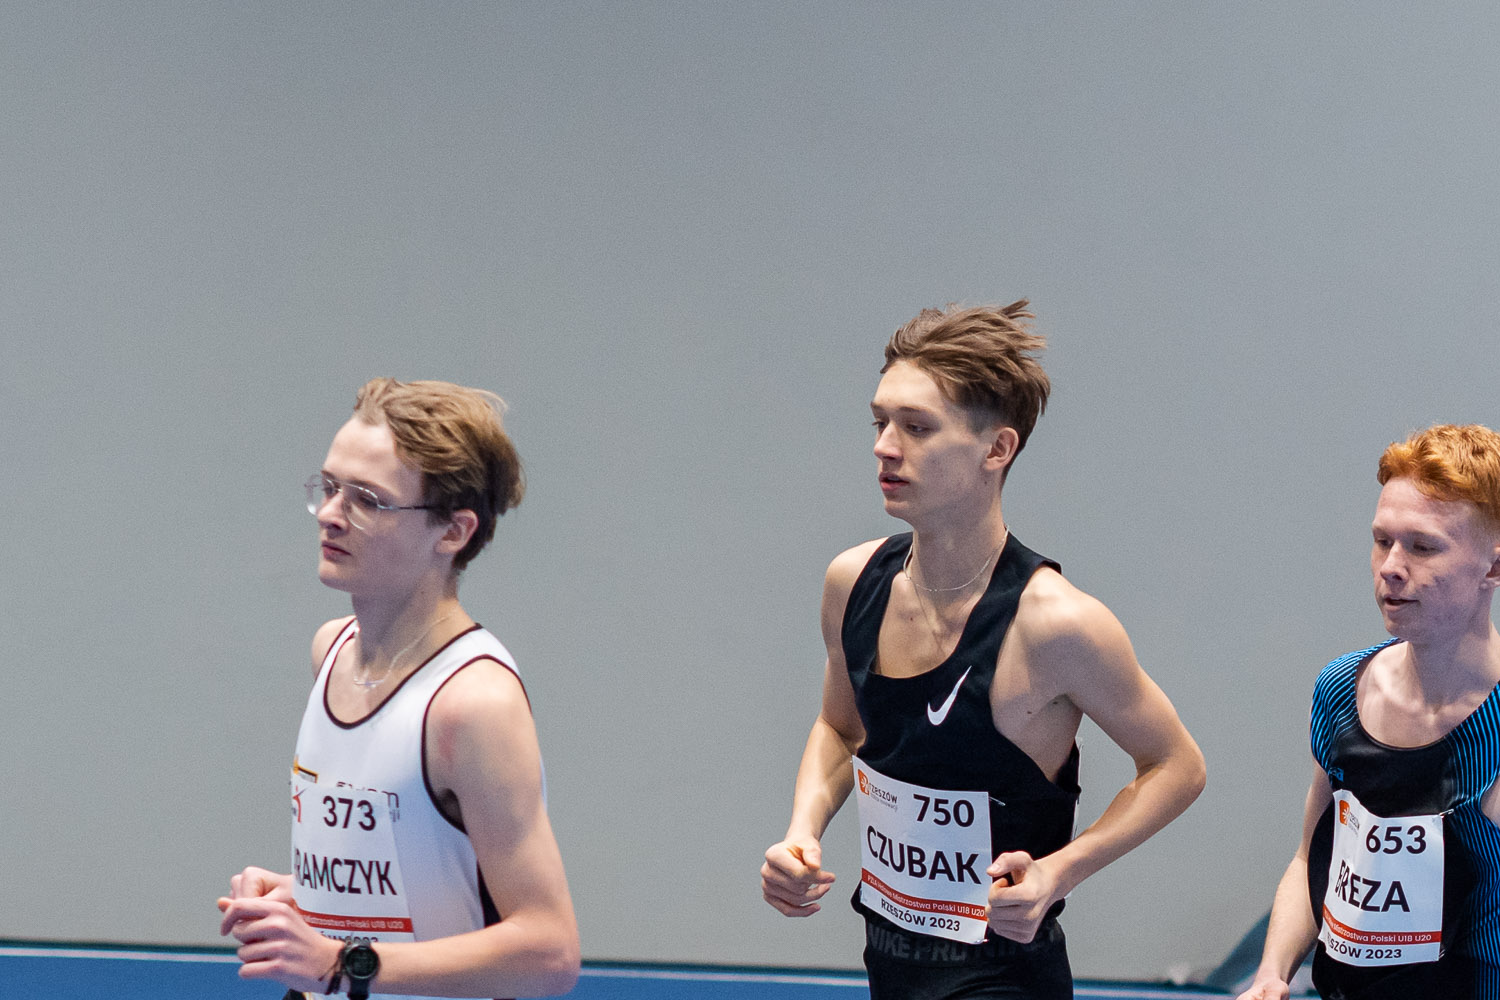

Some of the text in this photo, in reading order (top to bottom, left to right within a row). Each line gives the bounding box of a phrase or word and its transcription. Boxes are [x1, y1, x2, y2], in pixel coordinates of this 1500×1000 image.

[322, 795, 377, 832] 373
[913, 793, 975, 828] 750
[866, 825, 982, 885] CZUBAK
[1365, 824, 1427, 855] 653
[881, 898, 961, 932] RZESZÓW 2023
[933, 903, 956, 912] Polski
[957, 906, 970, 915] U18
[972, 908, 985, 917] U20
[1365, 948, 1402, 960] 2023
[1370, 934, 1396, 943] Polski
